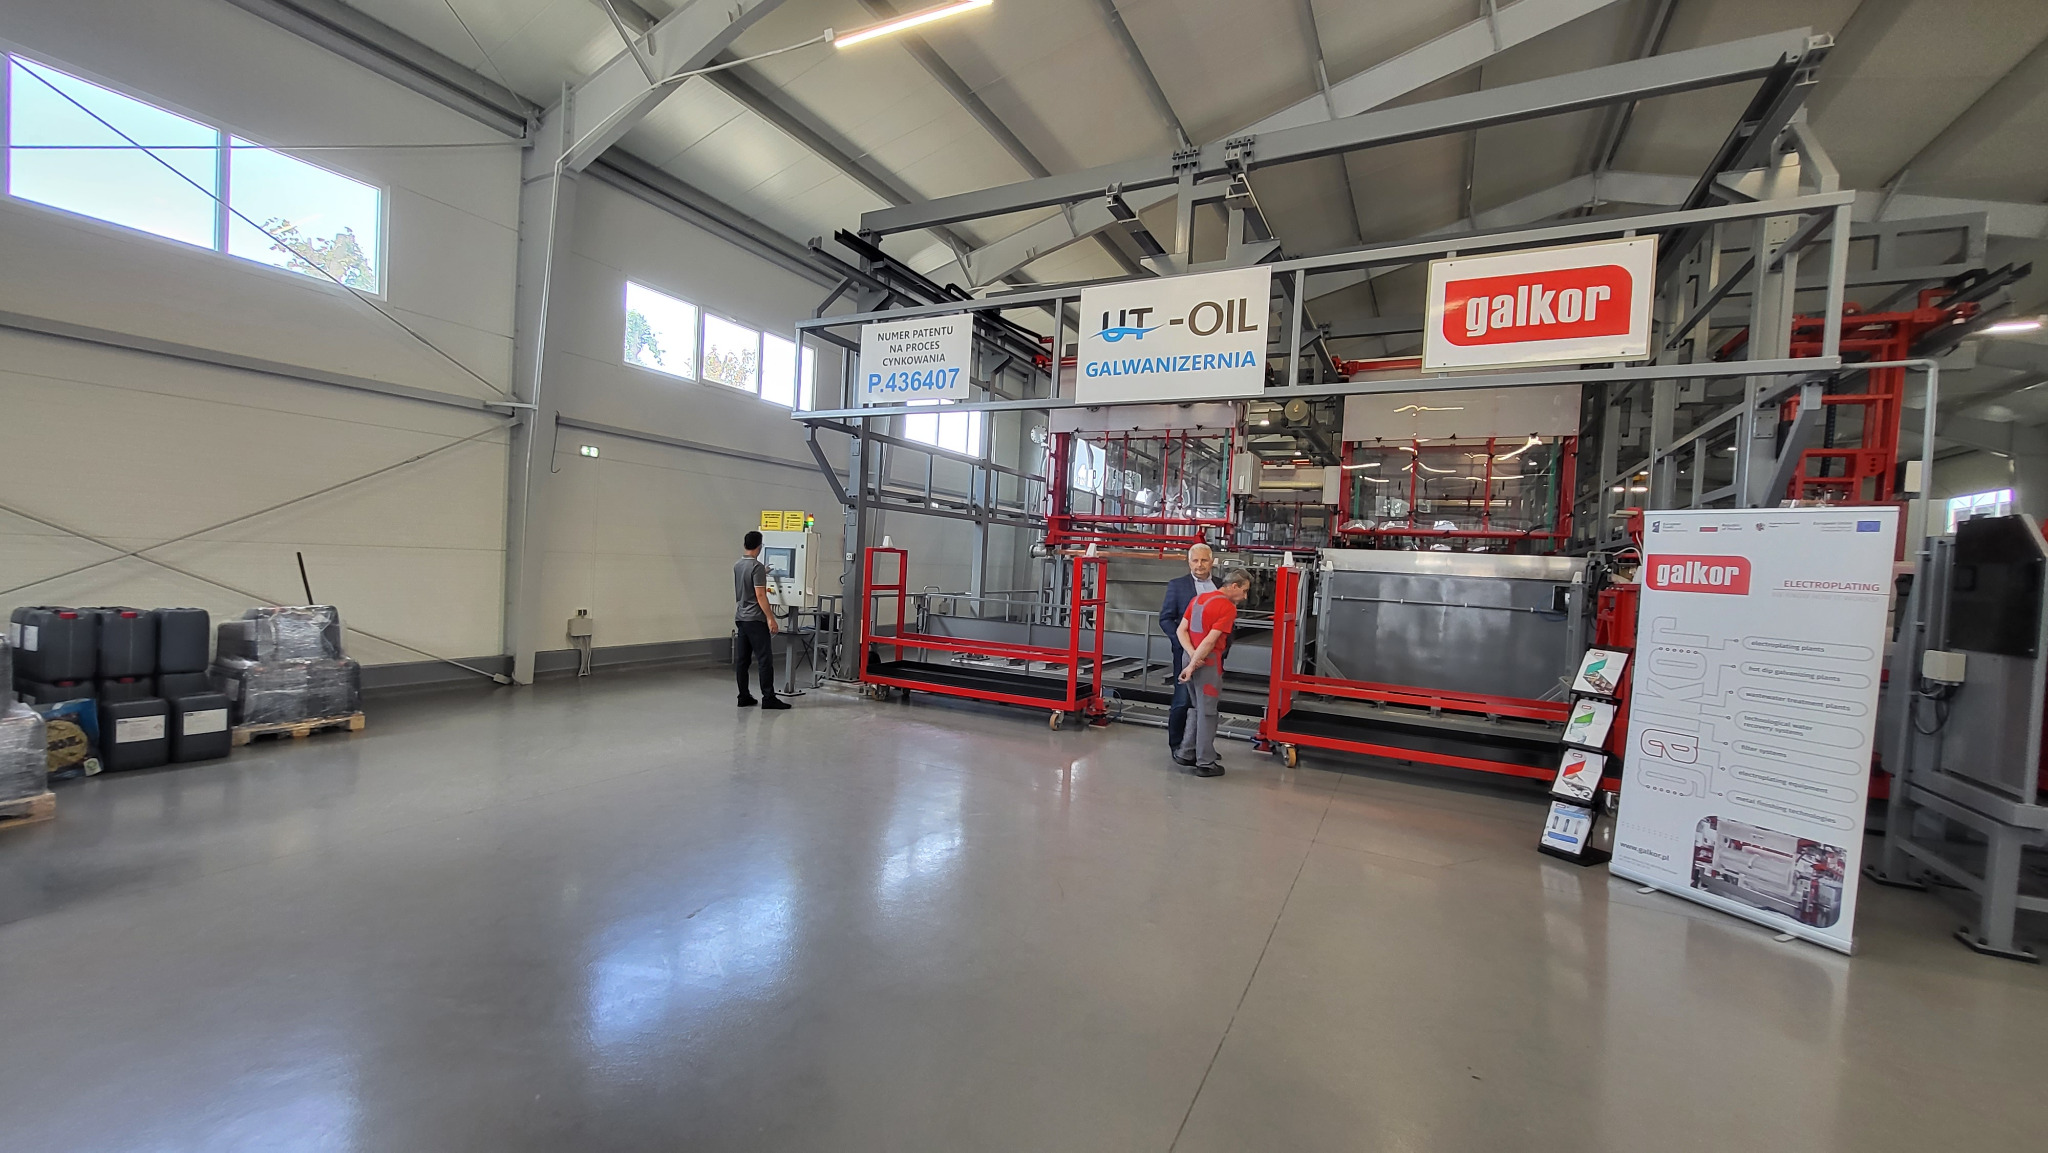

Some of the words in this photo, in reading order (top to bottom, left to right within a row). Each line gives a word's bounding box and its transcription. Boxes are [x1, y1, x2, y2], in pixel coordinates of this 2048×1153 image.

[1465, 283, 1611, 338] galkor
[878, 330, 910, 341] NUMER
[912, 326, 954, 339] PATENTU
[889, 344, 903, 354] NA
[906, 340, 940, 352] PROCES
[882, 353, 946, 367] CYNKOWANIA
[1085, 350, 1257, 378] GALWANIZERNIA
[868, 367, 960, 393] P.436407
[1656, 560, 1740, 587] galkor
[1784, 579, 1880, 592] ELECTROPLATING
[1751, 640, 1799, 651] electroplating
[1801, 644, 1825, 653] plants
[1748, 665, 1760, 673] hot
[1761, 667, 1773, 675] dip
[1774, 669, 1815, 680] galvanizing
[1816, 674, 1841, 682] plants
[1745, 692, 1786, 702] wastewater
[1787, 697, 1823, 708] treatment
[1825, 702, 1851, 711] plants
[1743, 722, 1773, 732] recovery
[1774, 727, 1804, 737] systems
[1744, 715, 1791, 728] technological
[1792, 723, 1813, 731] water
[1758, 748, 1787, 758] systems
[1738, 770, 1787, 786] electroplating
[1788, 781, 1828, 794] equipment
[1735, 796, 1756, 805] metal
[1756, 800, 1788, 813] finishing
[1788, 807, 1837, 824] technologies
[1620, 842, 1669, 861] www.galkor.pl
